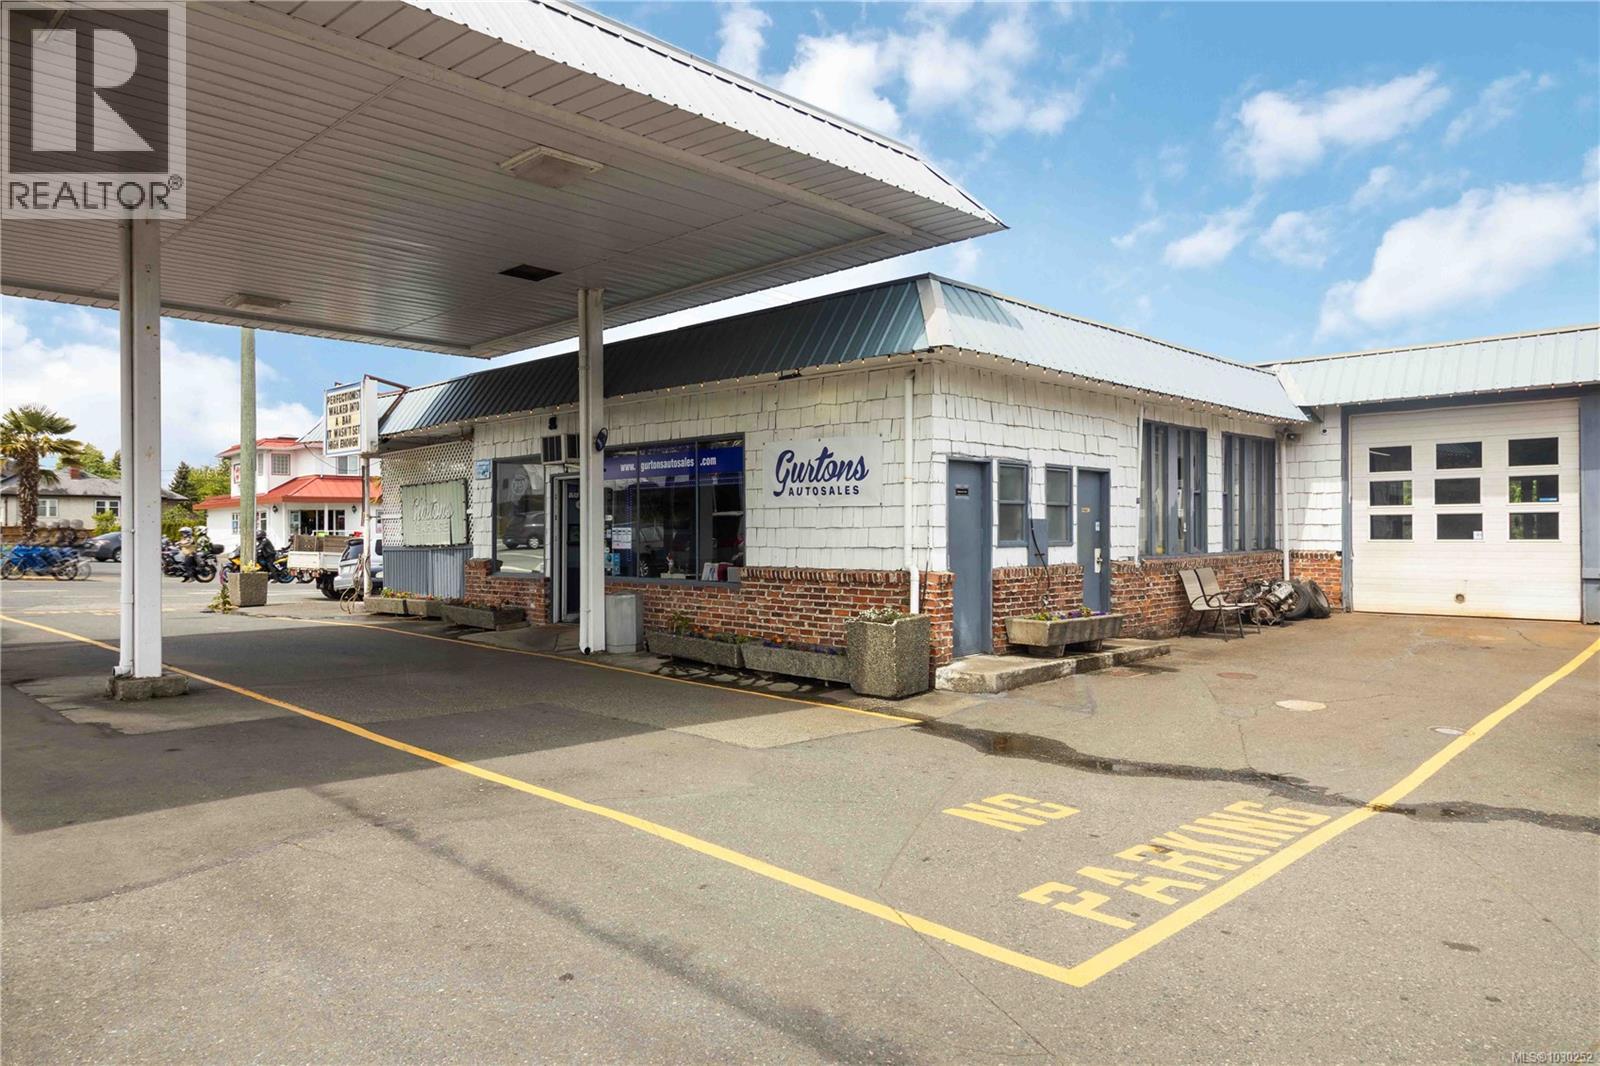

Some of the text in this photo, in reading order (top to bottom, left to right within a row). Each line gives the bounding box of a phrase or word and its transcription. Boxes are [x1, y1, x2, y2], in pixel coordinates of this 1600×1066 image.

[329, 401, 360, 416] WALKED INTO
[342, 415, 352, 426] BAR
[326, 429, 332, 439] IT
[353, 425, 361, 436] SET
[620, 456, 716, 472] www. gurtonsautosales .com
[773, 446, 869, 497] Gurtons
[788, 485, 860, 497] AUTOSALES
[942, 793, 1081, 833] NO
[1018, 800, 1331, 930] PARKING
